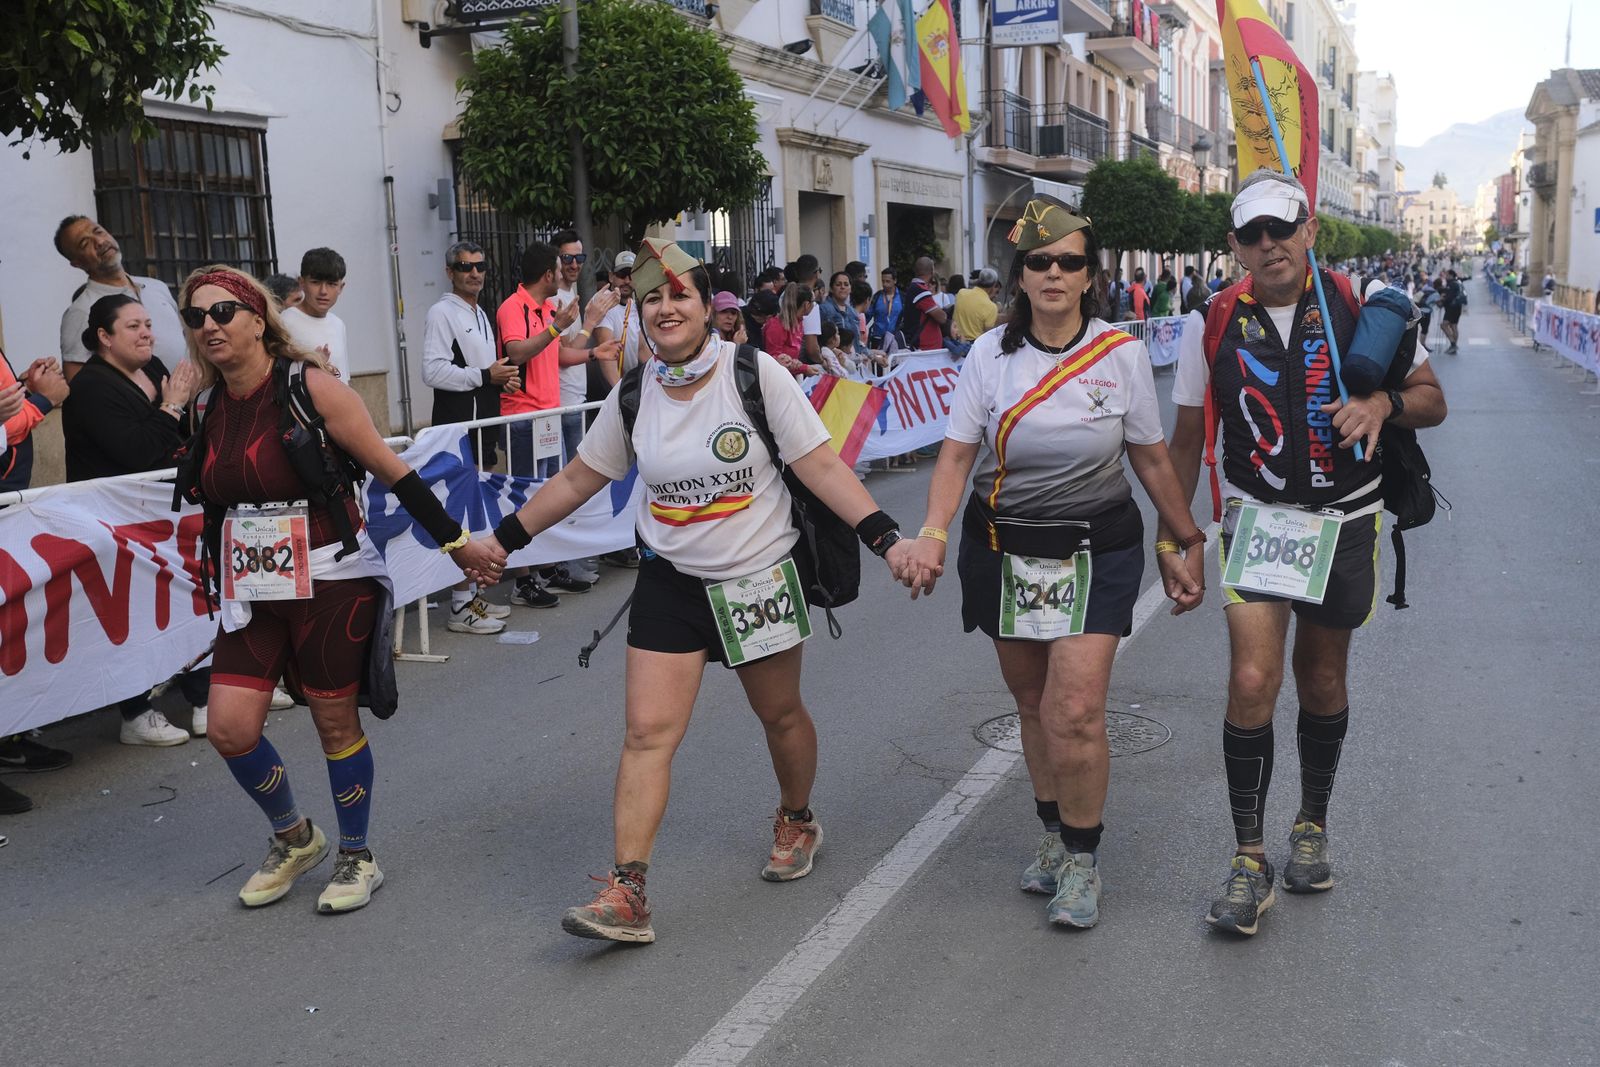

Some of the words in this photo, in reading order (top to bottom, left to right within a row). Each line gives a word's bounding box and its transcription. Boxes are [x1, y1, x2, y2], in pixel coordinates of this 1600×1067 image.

[1303, 338, 1335, 488] PEREGRINOS
[709, 466, 753, 486] XXIII
[1285, 519, 1308, 528] Unicaja
[233, 545, 294, 573] 3882
[1247, 534, 1316, 569] 3088
[1040, 562, 1062, 570] Unicaja
[752, 577, 774, 588] Unicaja
[1015, 582, 1075, 610] 3244
[732, 592, 794, 634] 3302
